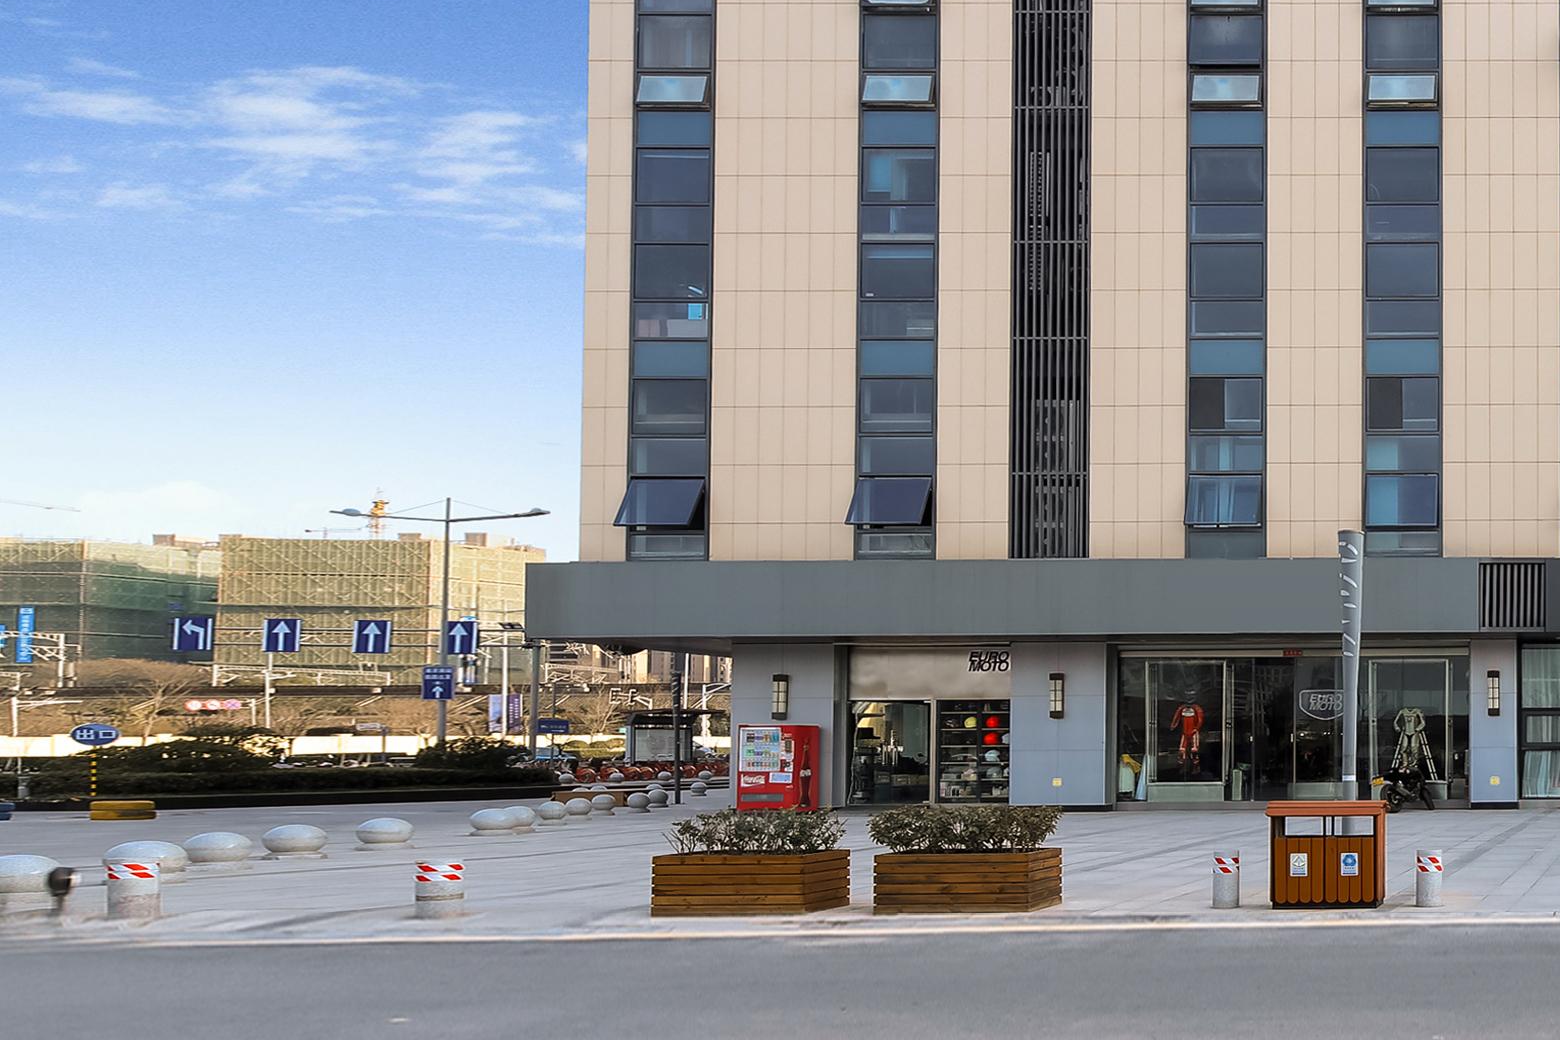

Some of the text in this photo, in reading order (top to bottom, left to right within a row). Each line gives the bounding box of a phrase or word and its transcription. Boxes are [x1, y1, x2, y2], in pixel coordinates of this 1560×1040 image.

[970, 651, 1009, 662] EURO
[968, 661, 1009, 671] MOTO
[1309, 702, 1342, 710] MOTO
[76, 729, 116, 740] 出口
